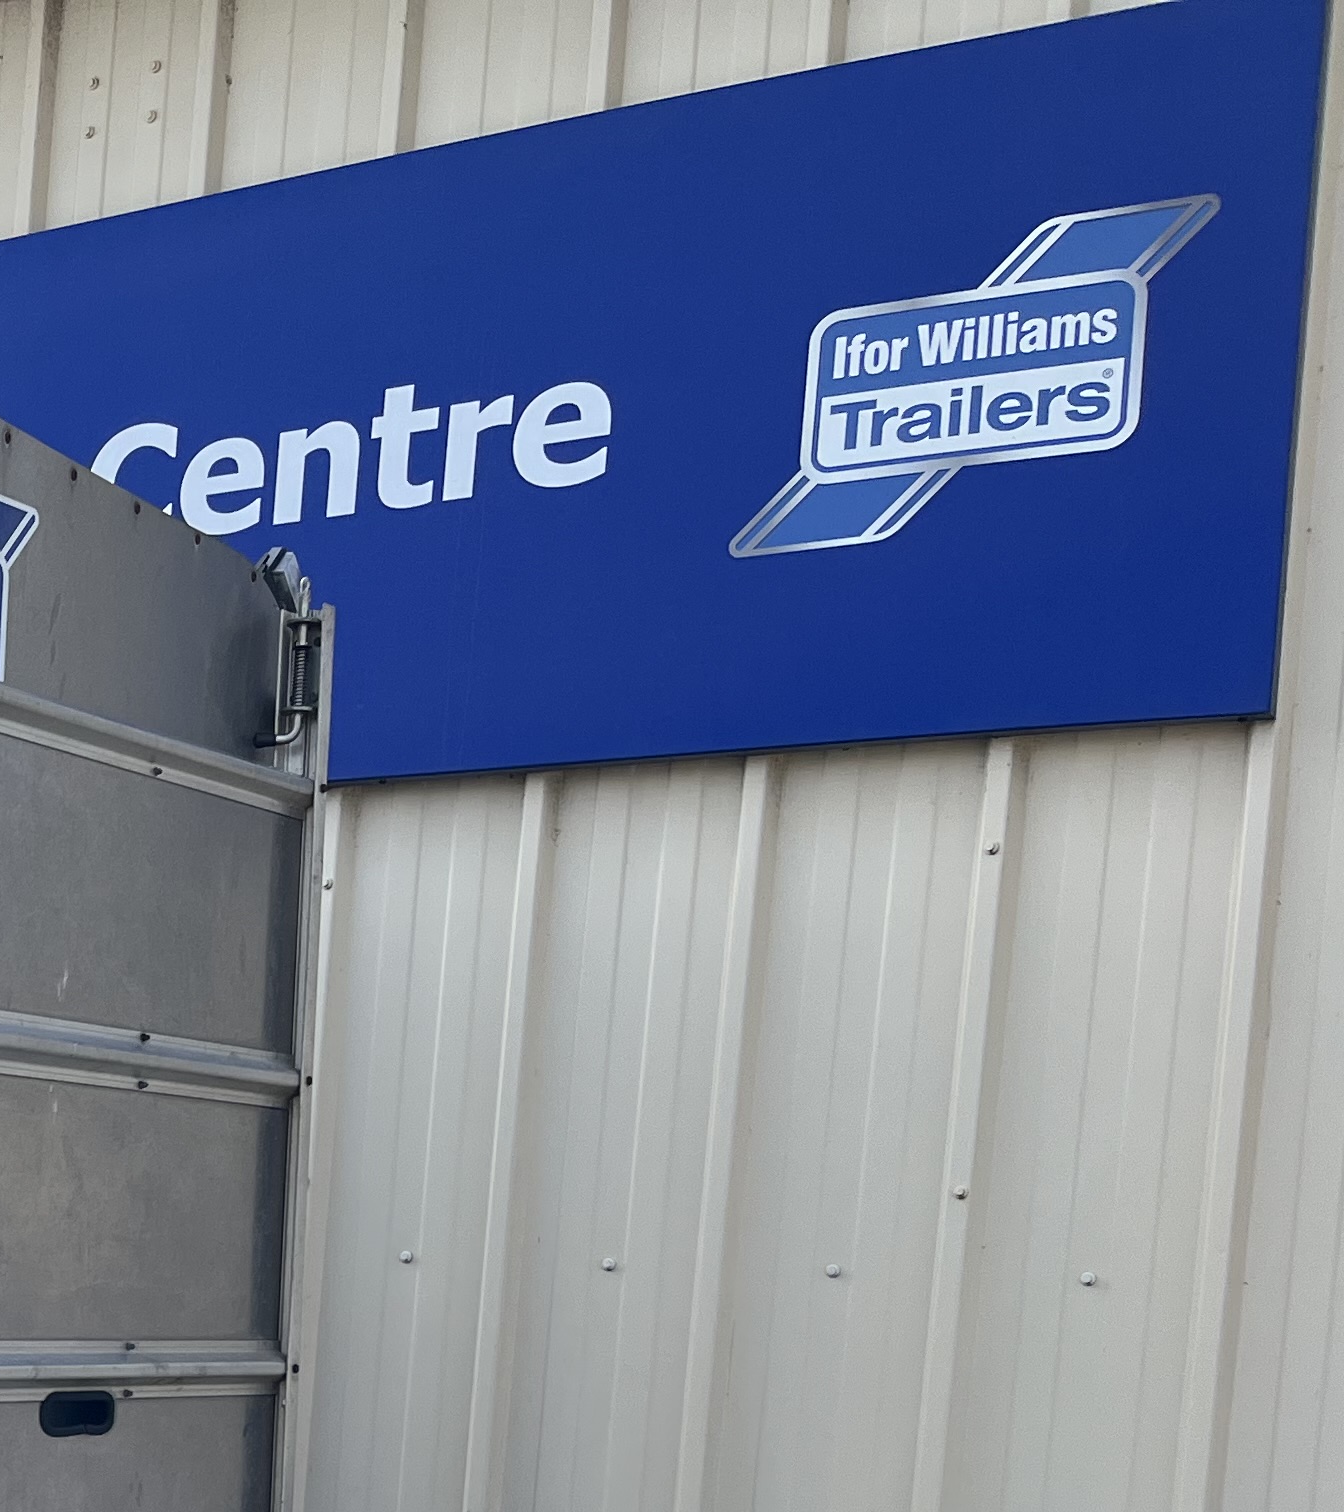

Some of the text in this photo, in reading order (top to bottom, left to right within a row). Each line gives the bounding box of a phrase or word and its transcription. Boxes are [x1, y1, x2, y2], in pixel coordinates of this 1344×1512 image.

[832, 308, 1118, 380] Ifor Williams
[830, 381, 1111, 451] Trailers
[90, 381, 612, 536] Centre
